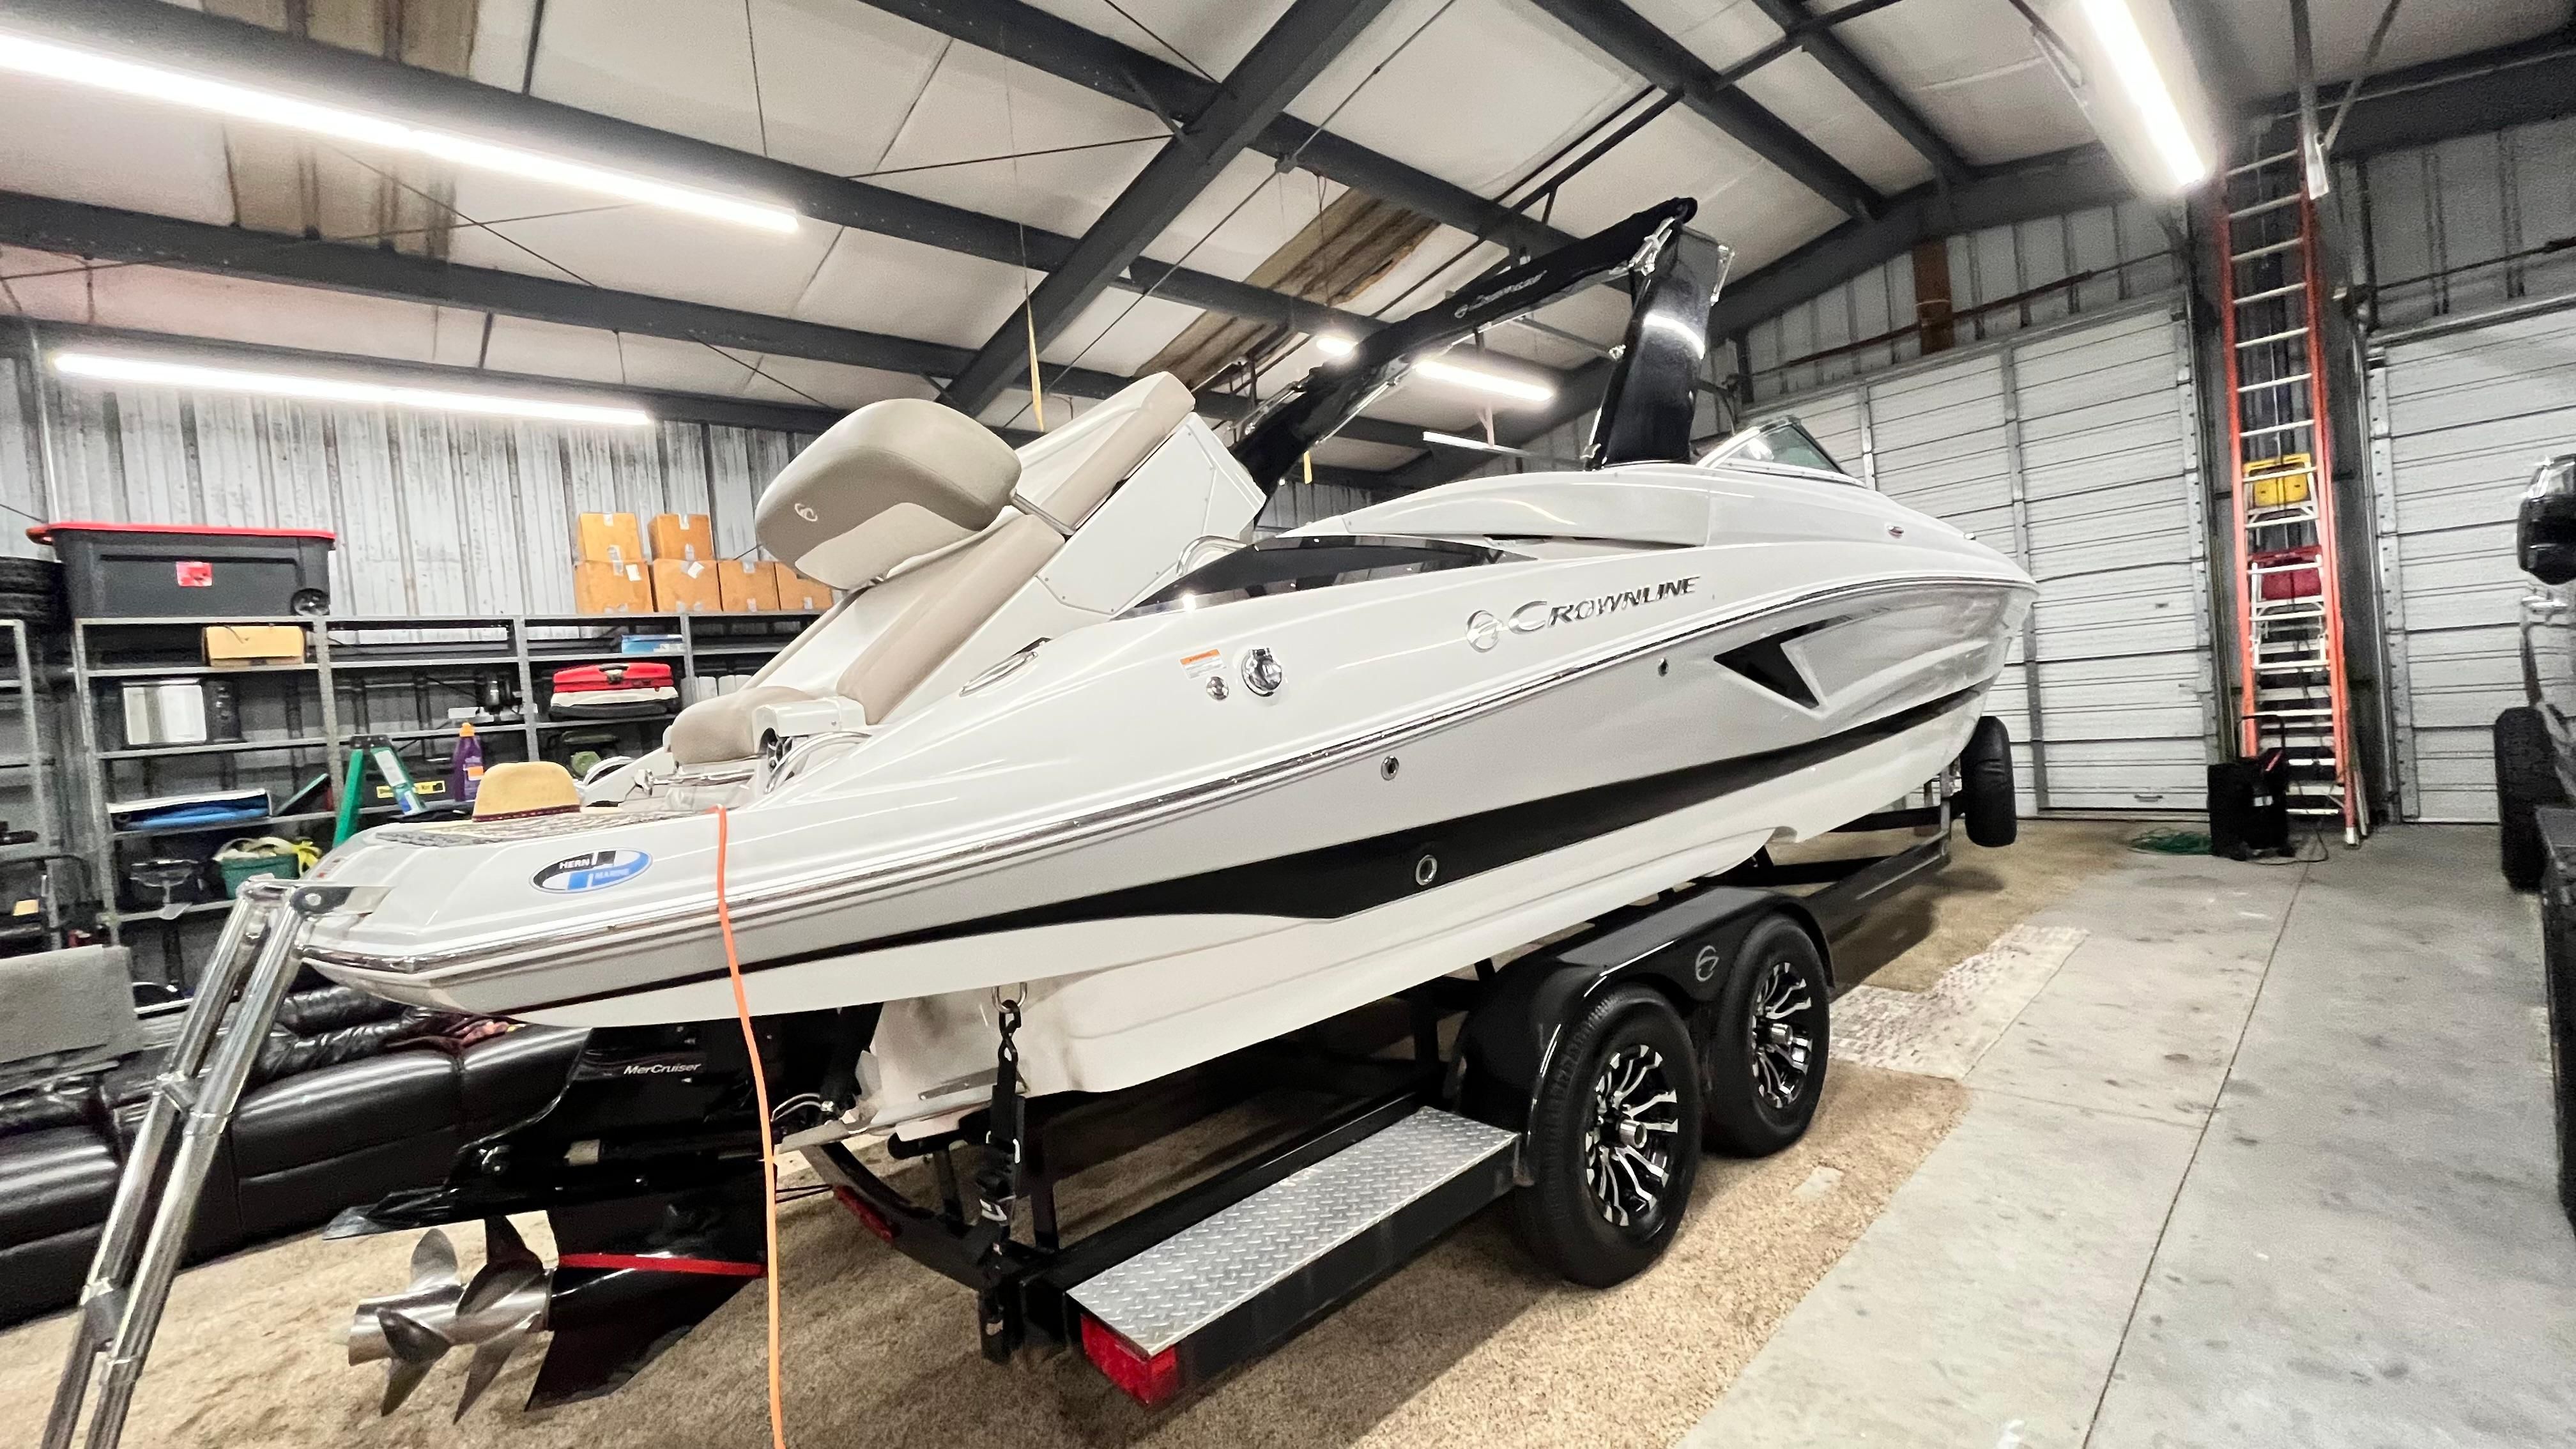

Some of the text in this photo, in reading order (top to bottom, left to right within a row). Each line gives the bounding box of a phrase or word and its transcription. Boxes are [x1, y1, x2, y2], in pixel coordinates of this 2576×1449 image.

[1508, 575, 1700, 634] CROWNLINE
[559, 859, 590, 869] HERN
[624, 1063, 702, 1075] MerCruiser
